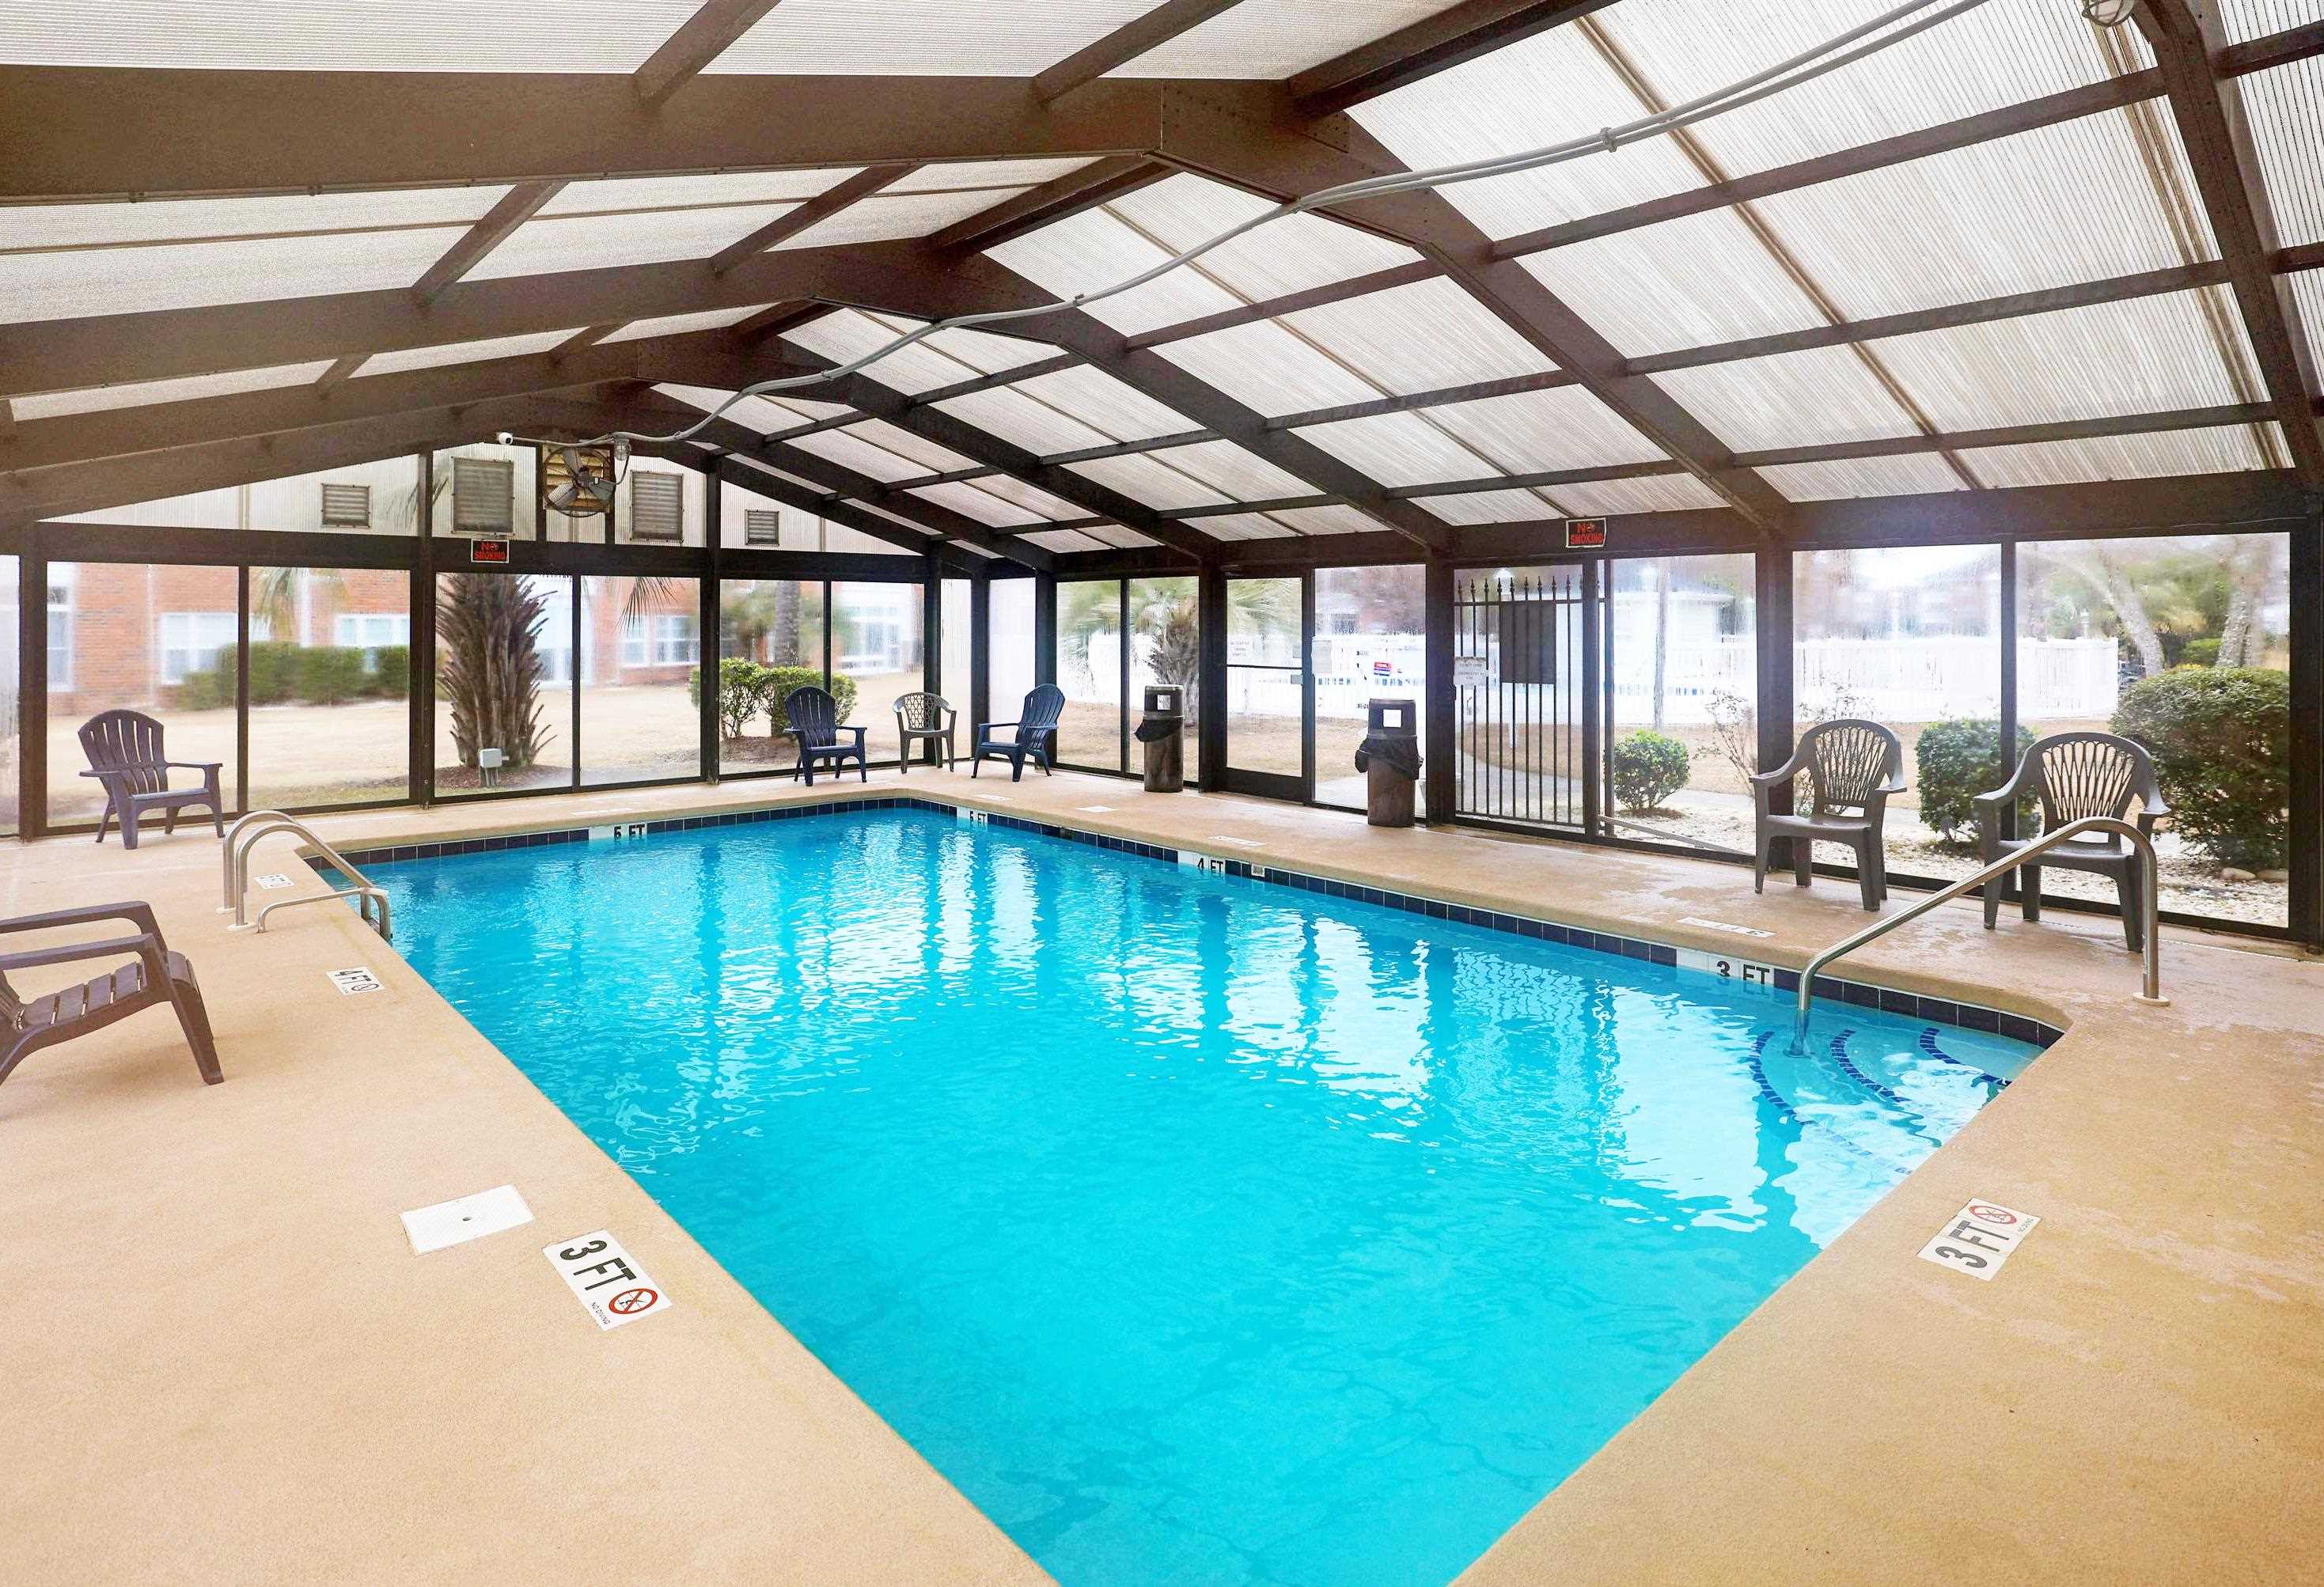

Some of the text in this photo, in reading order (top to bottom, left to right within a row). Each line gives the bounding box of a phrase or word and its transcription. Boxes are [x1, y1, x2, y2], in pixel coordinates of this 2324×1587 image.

[1570, 532, 1604, 544] SMOKING
[475, 551, 506, 560] SMOKING
[978, 813, 987, 824] FT
[628, 824, 646, 836] FT
[1210, 859, 1224, 873] FT
[1716, 960, 1771, 985] 3 FT
[338, 974, 372, 985] FT
[1935, 1220, 2010, 1268] 3 FT
[559, 1240, 637, 1291] 3 FT
